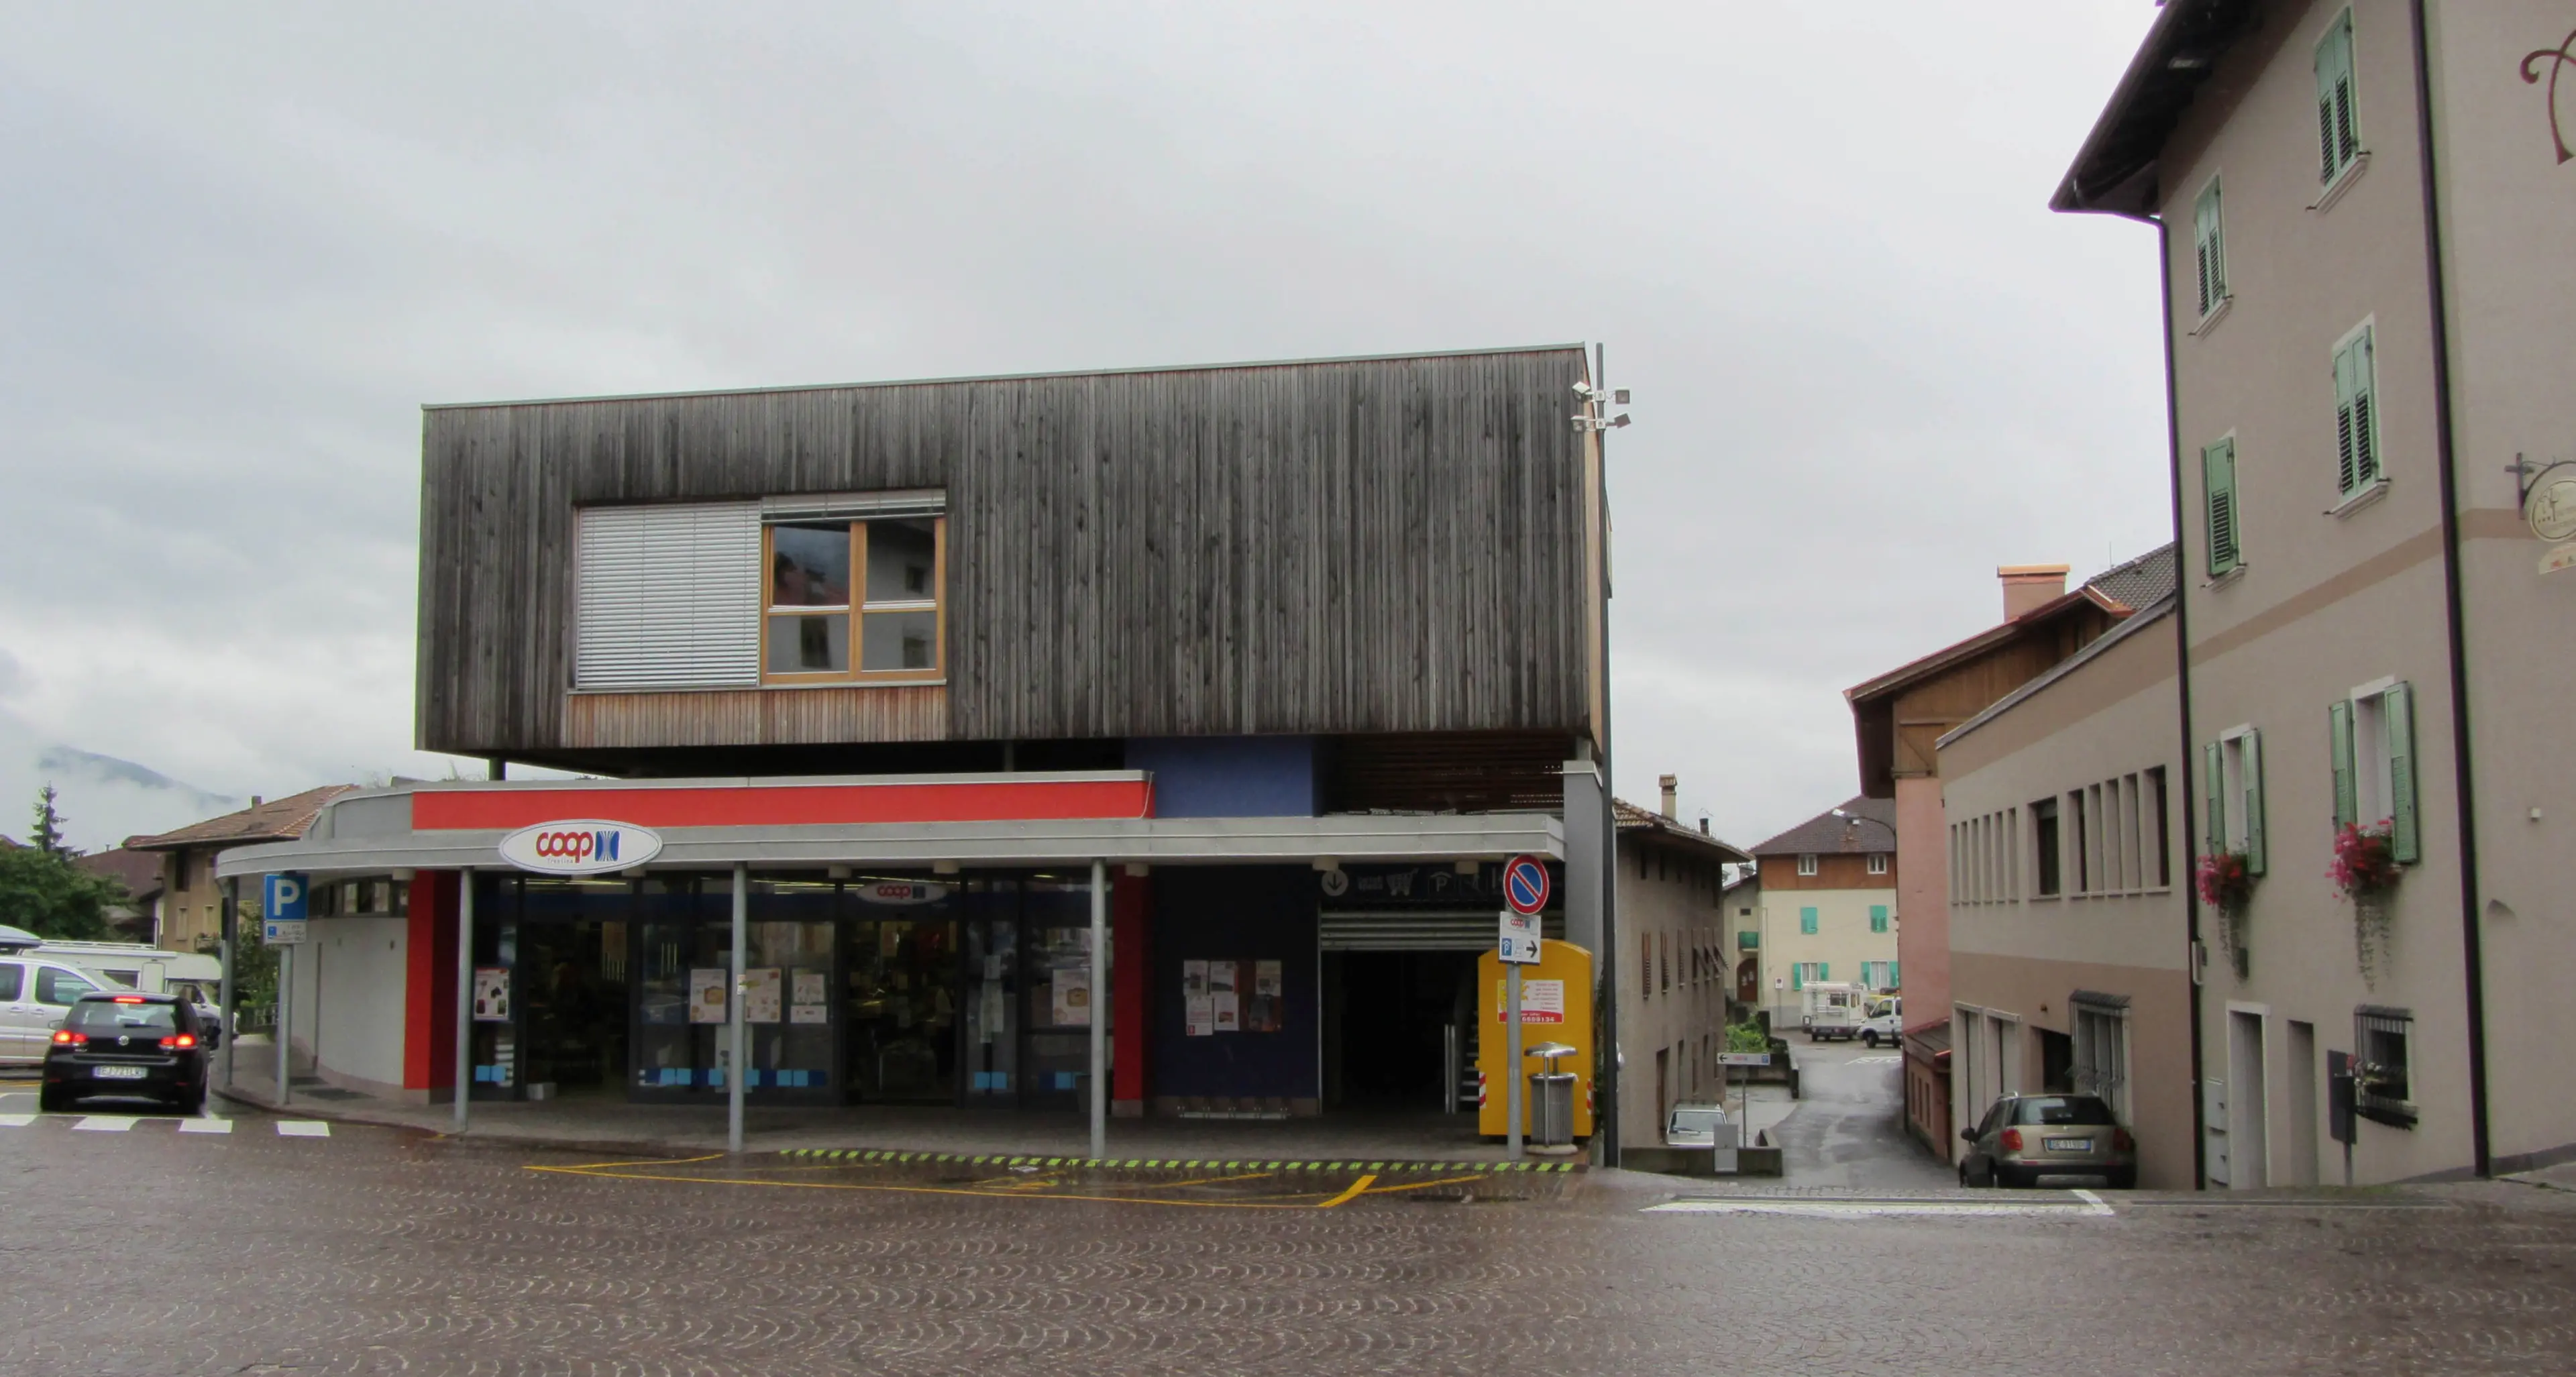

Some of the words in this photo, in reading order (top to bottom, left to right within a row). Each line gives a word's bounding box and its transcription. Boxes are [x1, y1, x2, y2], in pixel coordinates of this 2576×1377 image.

[536, 832, 593, 863] coop
[274, 879, 300, 916] P
[877, 885, 911, 899] coop
